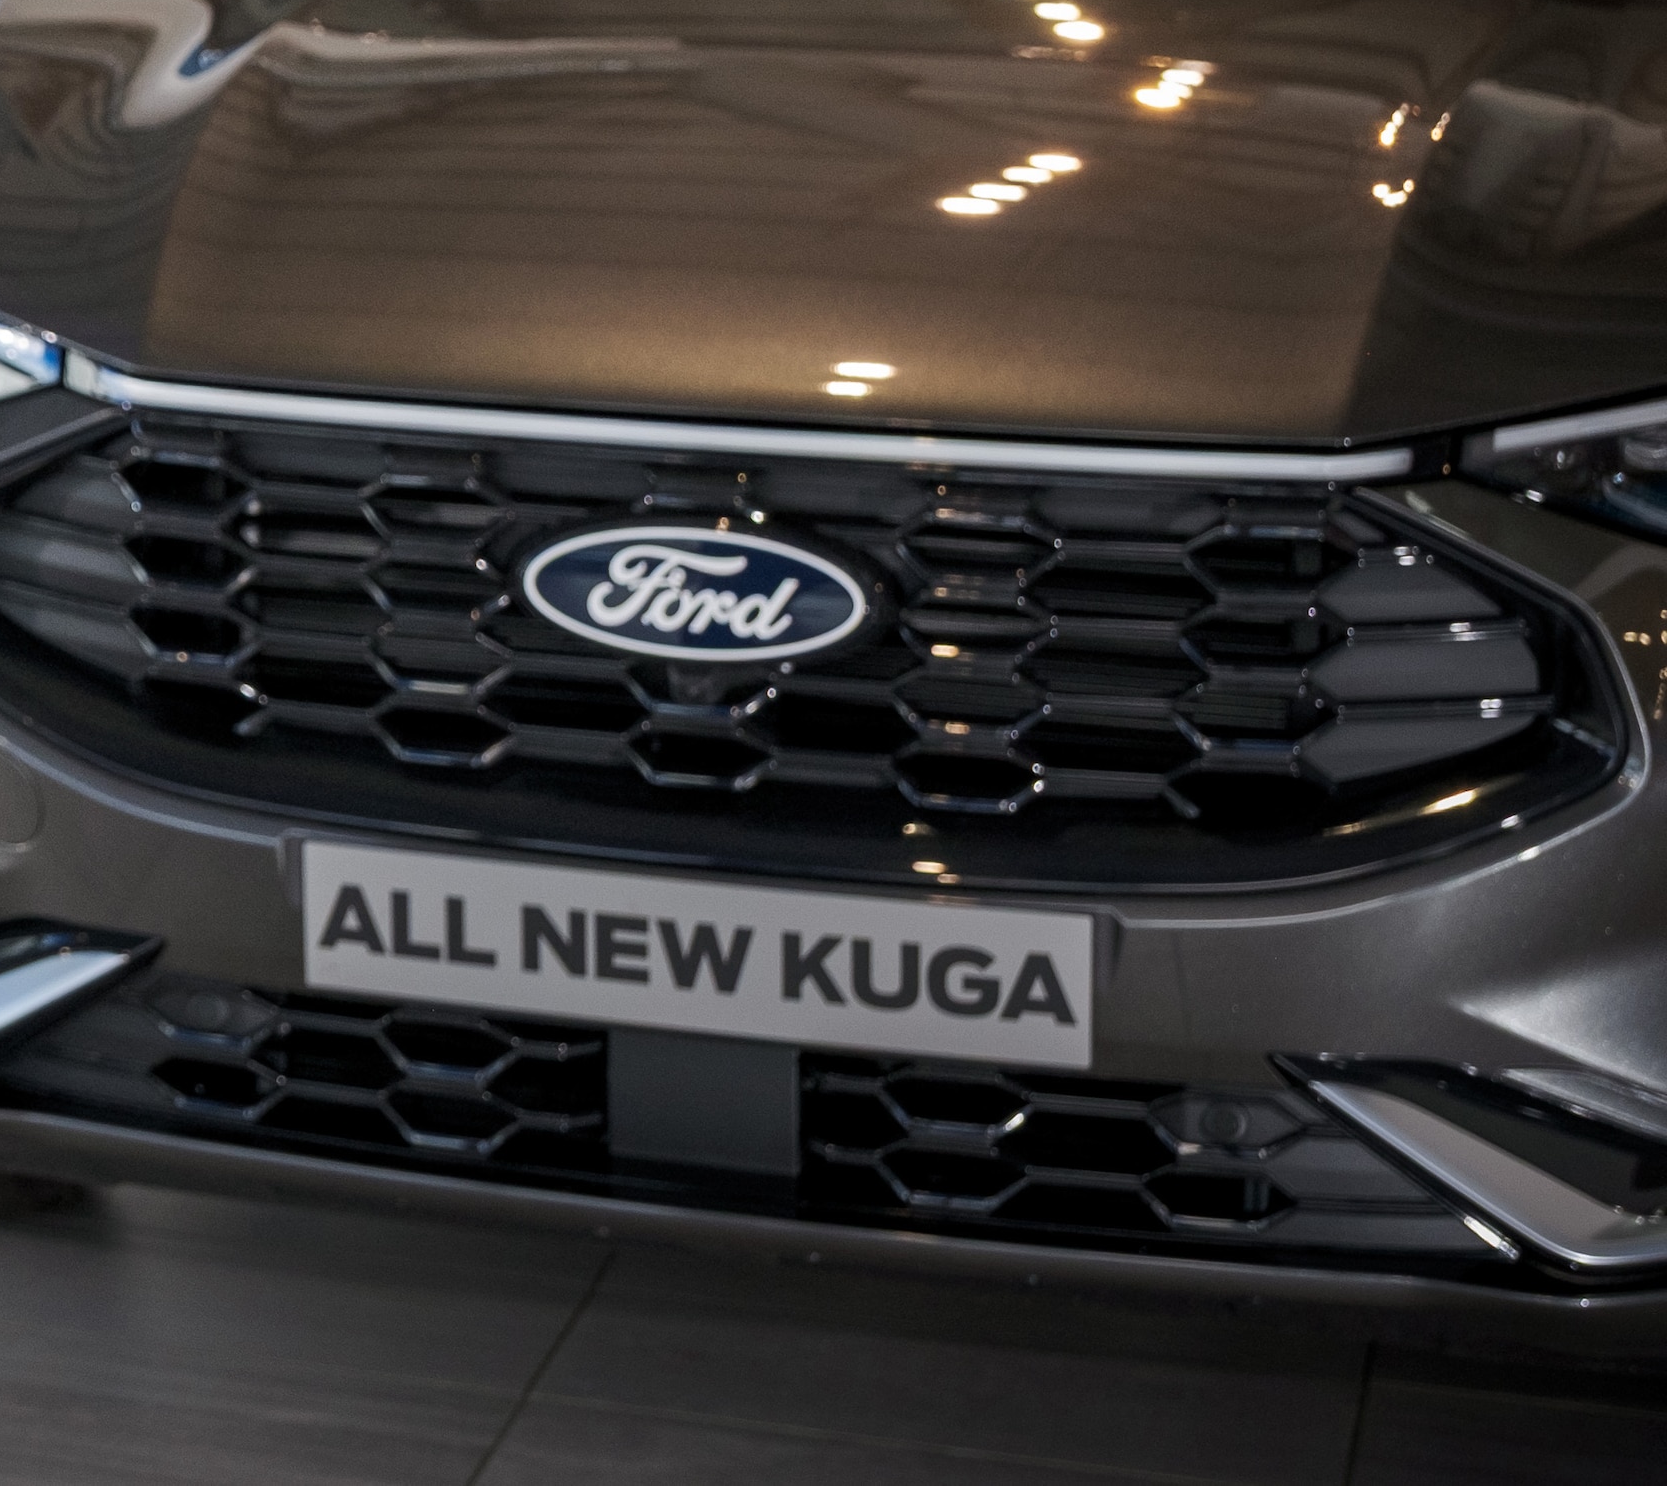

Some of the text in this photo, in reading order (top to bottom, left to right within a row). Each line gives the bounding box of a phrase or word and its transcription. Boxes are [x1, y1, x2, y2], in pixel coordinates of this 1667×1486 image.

[586, 544, 800, 641] Ford
[320, 884, 1077, 1026] ALL NEW KUGA
